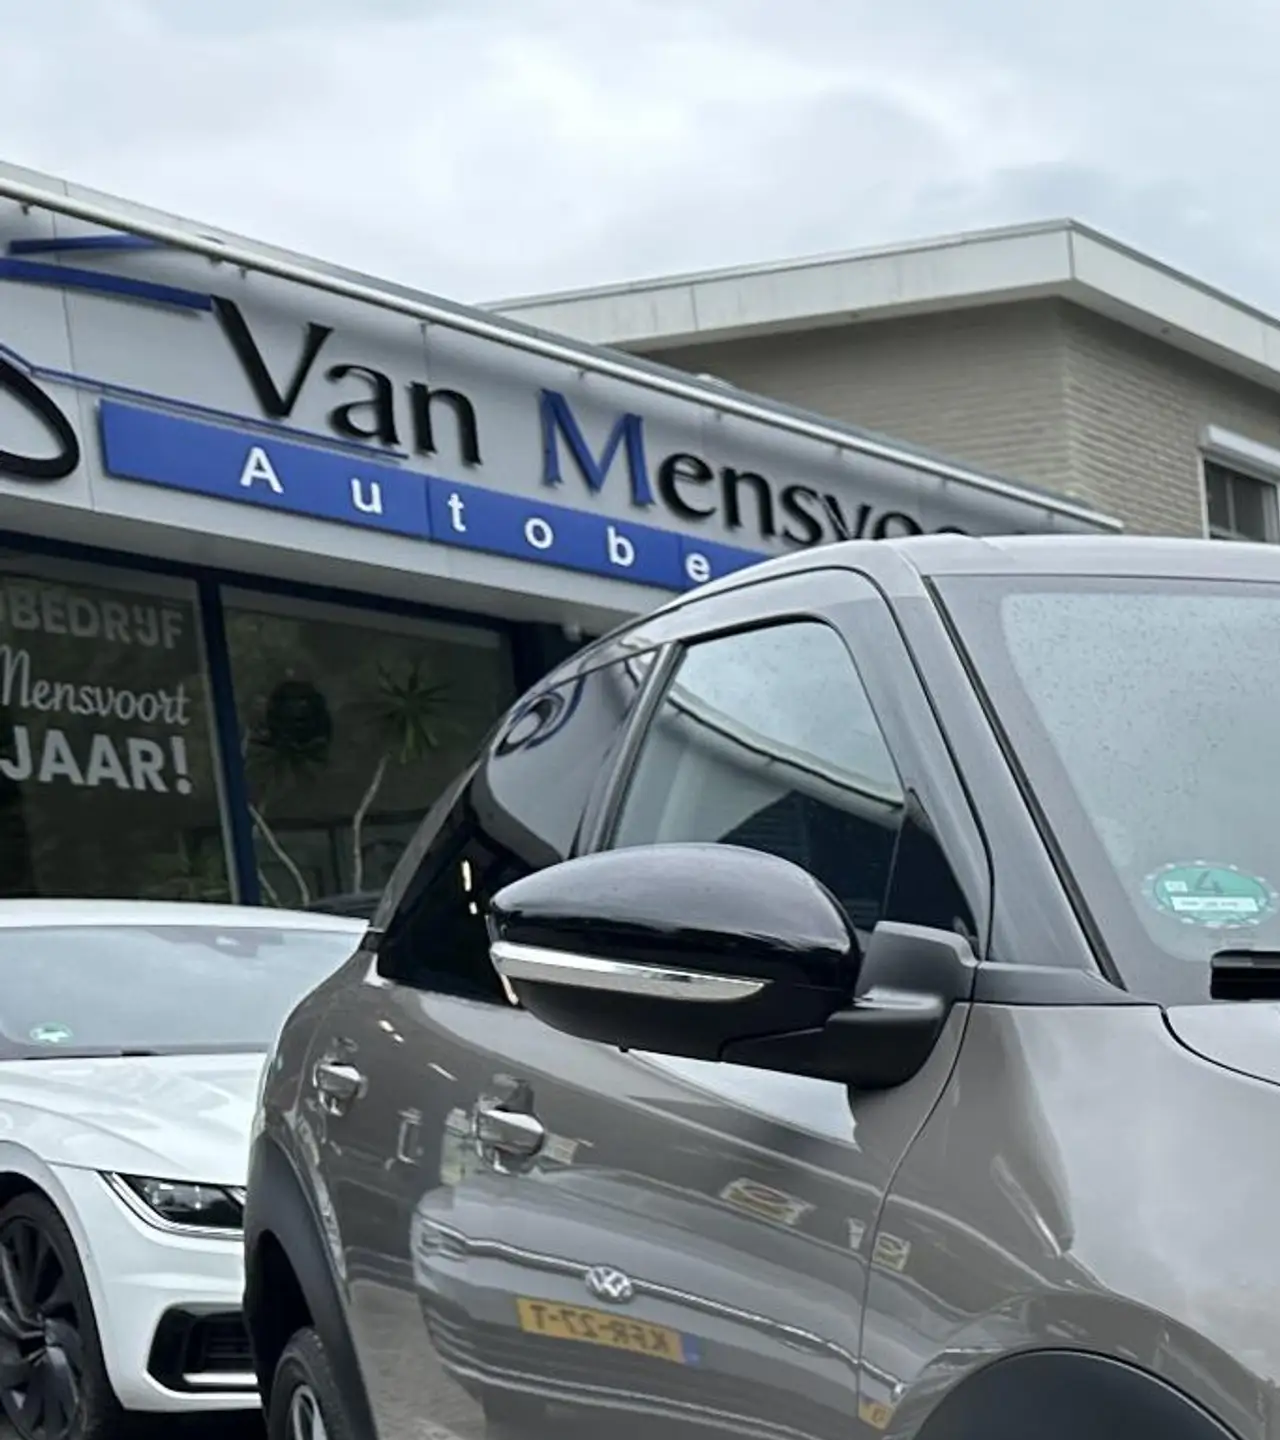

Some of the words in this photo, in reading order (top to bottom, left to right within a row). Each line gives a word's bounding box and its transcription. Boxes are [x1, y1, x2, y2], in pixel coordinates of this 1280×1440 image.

[210, 295, 482, 467] Van
[239, 446, 711, 585] Autobe
[0, 585, 184, 650] BEDRIJF
[0, 725, 193, 795] JAAR!
